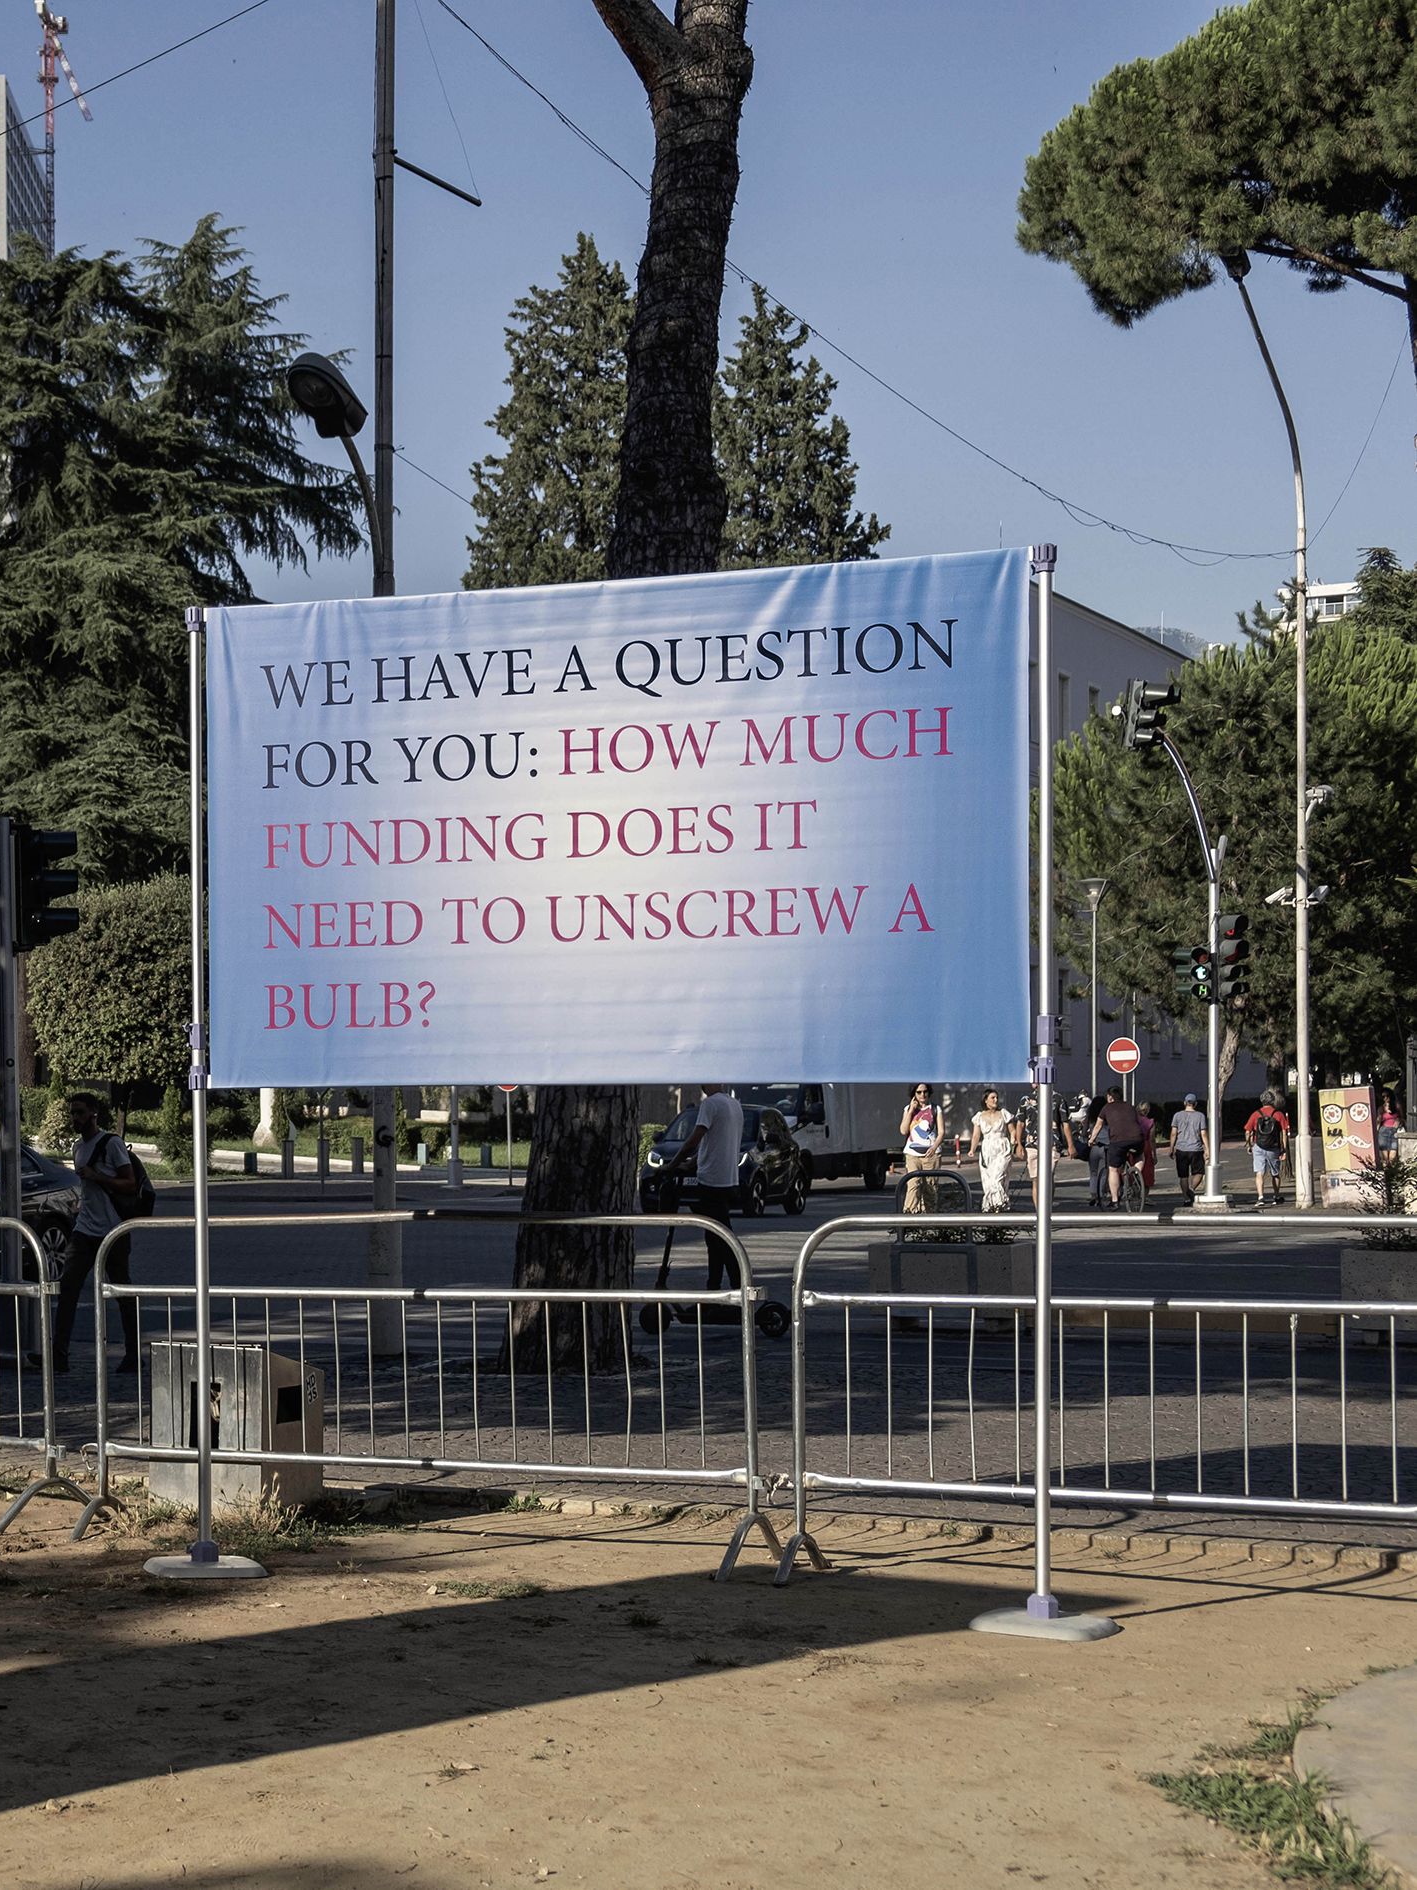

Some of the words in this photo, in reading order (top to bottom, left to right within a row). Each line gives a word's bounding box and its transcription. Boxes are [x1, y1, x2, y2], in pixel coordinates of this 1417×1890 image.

[259, 660, 354, 709] WE
[371, 648, 536, 703] HAVE
[553, 645, 596, 693] A
[615, 618, 958, 697] QUESTION
[263, 740, 379, 789] FOR
[393, 732, 539, 783] YOU:
[558, 721, 720, 775] HOW
[740, 707, 953, 766] MUCH
[264, 813, 547, 868] FUNDING
[567, 805, 733, 858] DOES
[754, 800, 817, 851] IT
[264, 901, 423, 948] NEED
[442, 897, 525, 944] TO
[546, 886, 869, 943] UNSCREW
[888, 883, 935, 933] A
[264, 981, 436, 1030] BULB?
